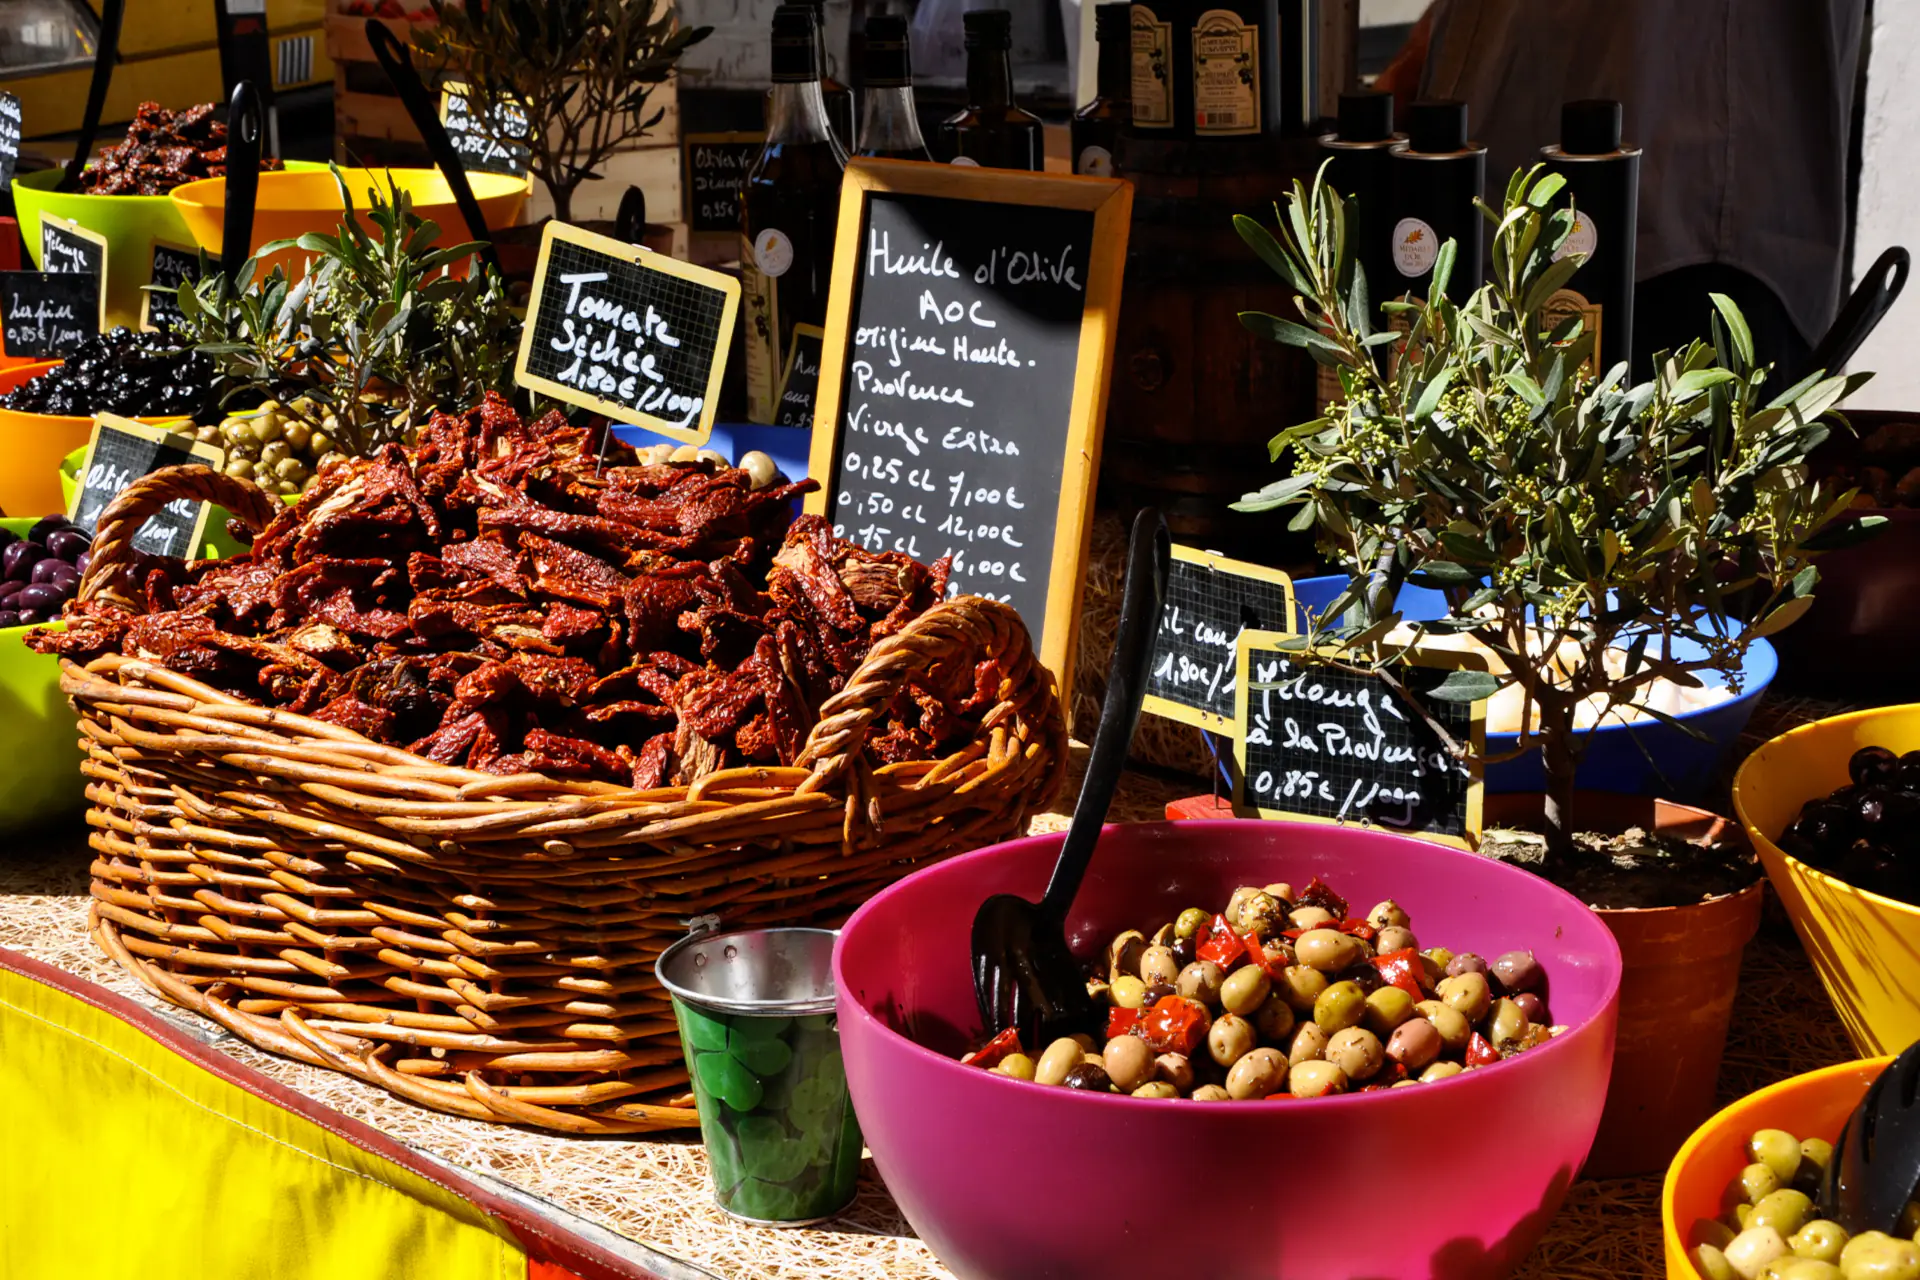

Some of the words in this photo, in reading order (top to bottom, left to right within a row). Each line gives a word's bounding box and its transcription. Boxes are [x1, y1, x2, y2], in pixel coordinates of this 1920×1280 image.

[869, 228, 960, 278] Huile
[974, 245, 1082, 291] d'Olive
[560, 272, 680, 347] Tomate
[919, 289, 996, 328] AOC
[852, 360, 974, 408] Provence
[848, 403, 929, 456] Vierge
[845, 452, 903, 484] 0,25
[949, 471, 1024, 509] 7,00€
[838, 491, 893, 515] 0,50
[938, 514, 1023, 547] 12,00€
[1159, 603, 1184, 636] il
[1282, 718, 1319, 752] la
